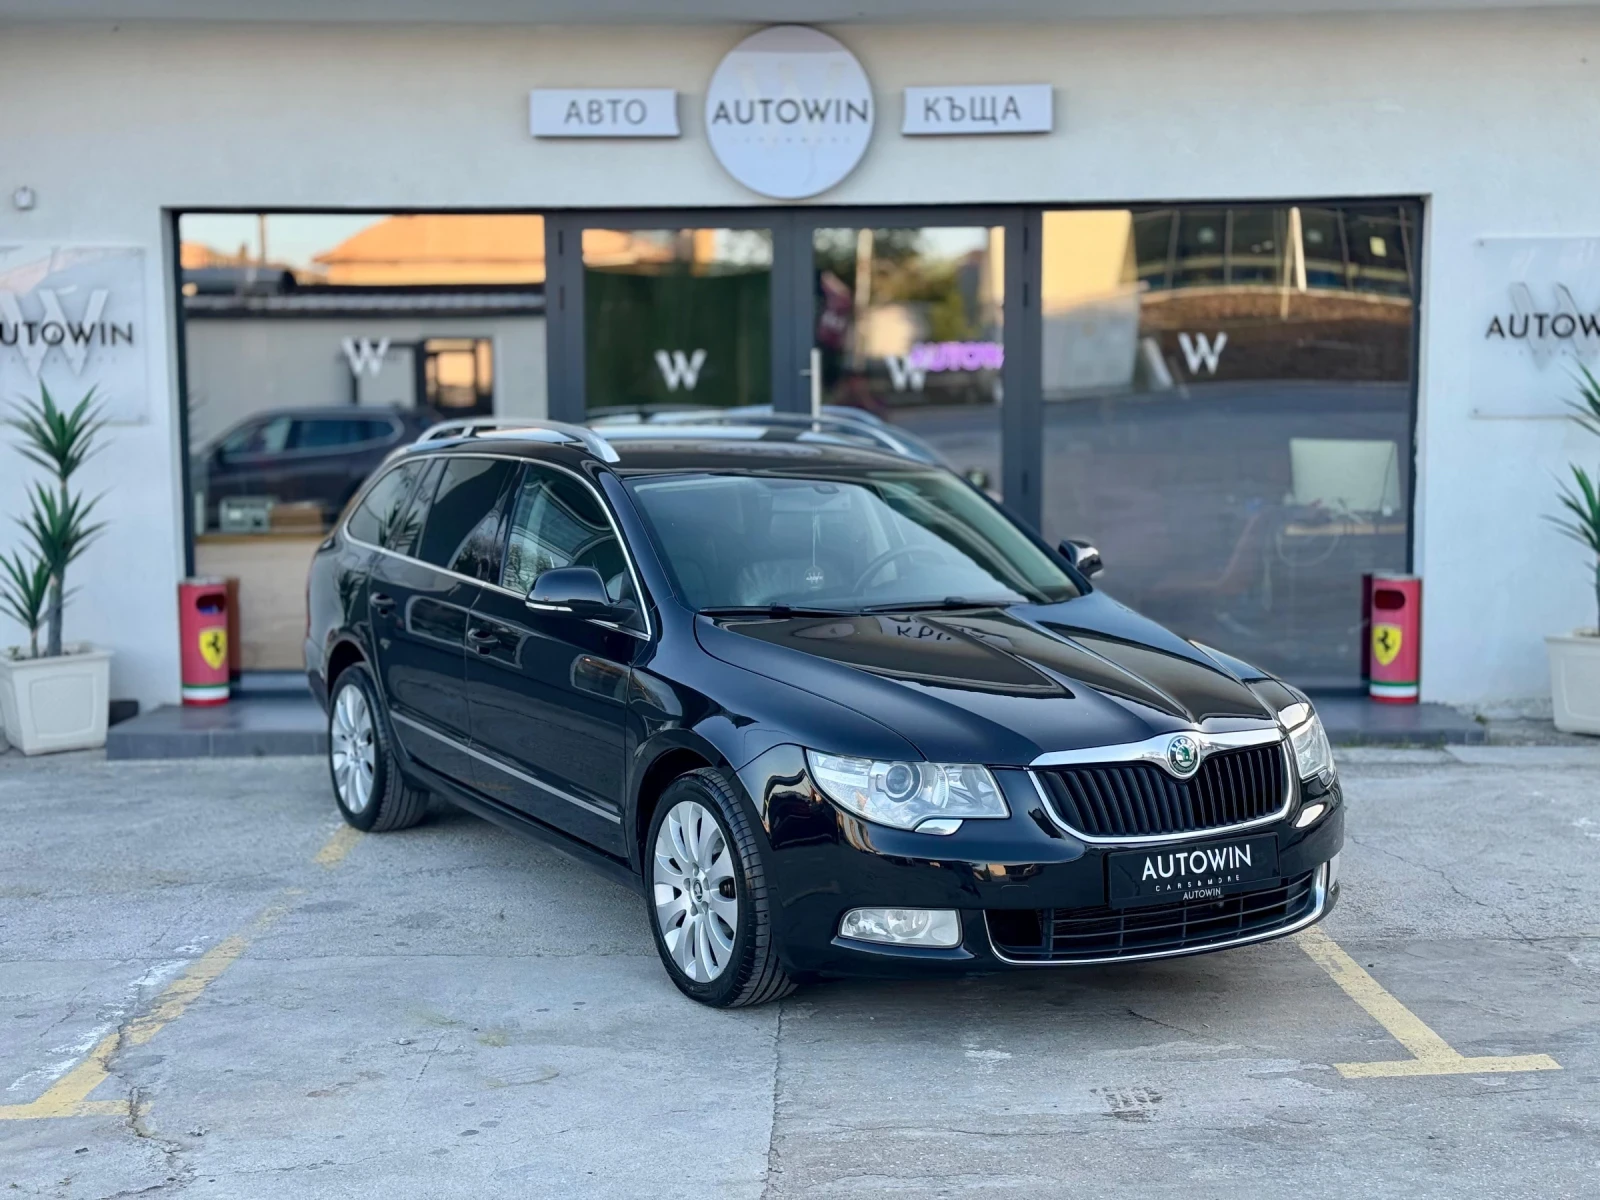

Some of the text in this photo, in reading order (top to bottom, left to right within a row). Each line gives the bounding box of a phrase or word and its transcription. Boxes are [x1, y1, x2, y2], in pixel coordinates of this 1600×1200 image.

[563, 98, 648, 126] АВТО
[711, 98, 869, 125] AUTOWIN
[923, 95, 1022, 126] КЪЩА
[341, 336, 390, 379] W
[654, 348, 708, 392] W
[1177, 331, 1228, 375] W
[1142, 844, 1252, 881] AUTOWIN
[1182, 887, 1222, 900] AUTOWIN
